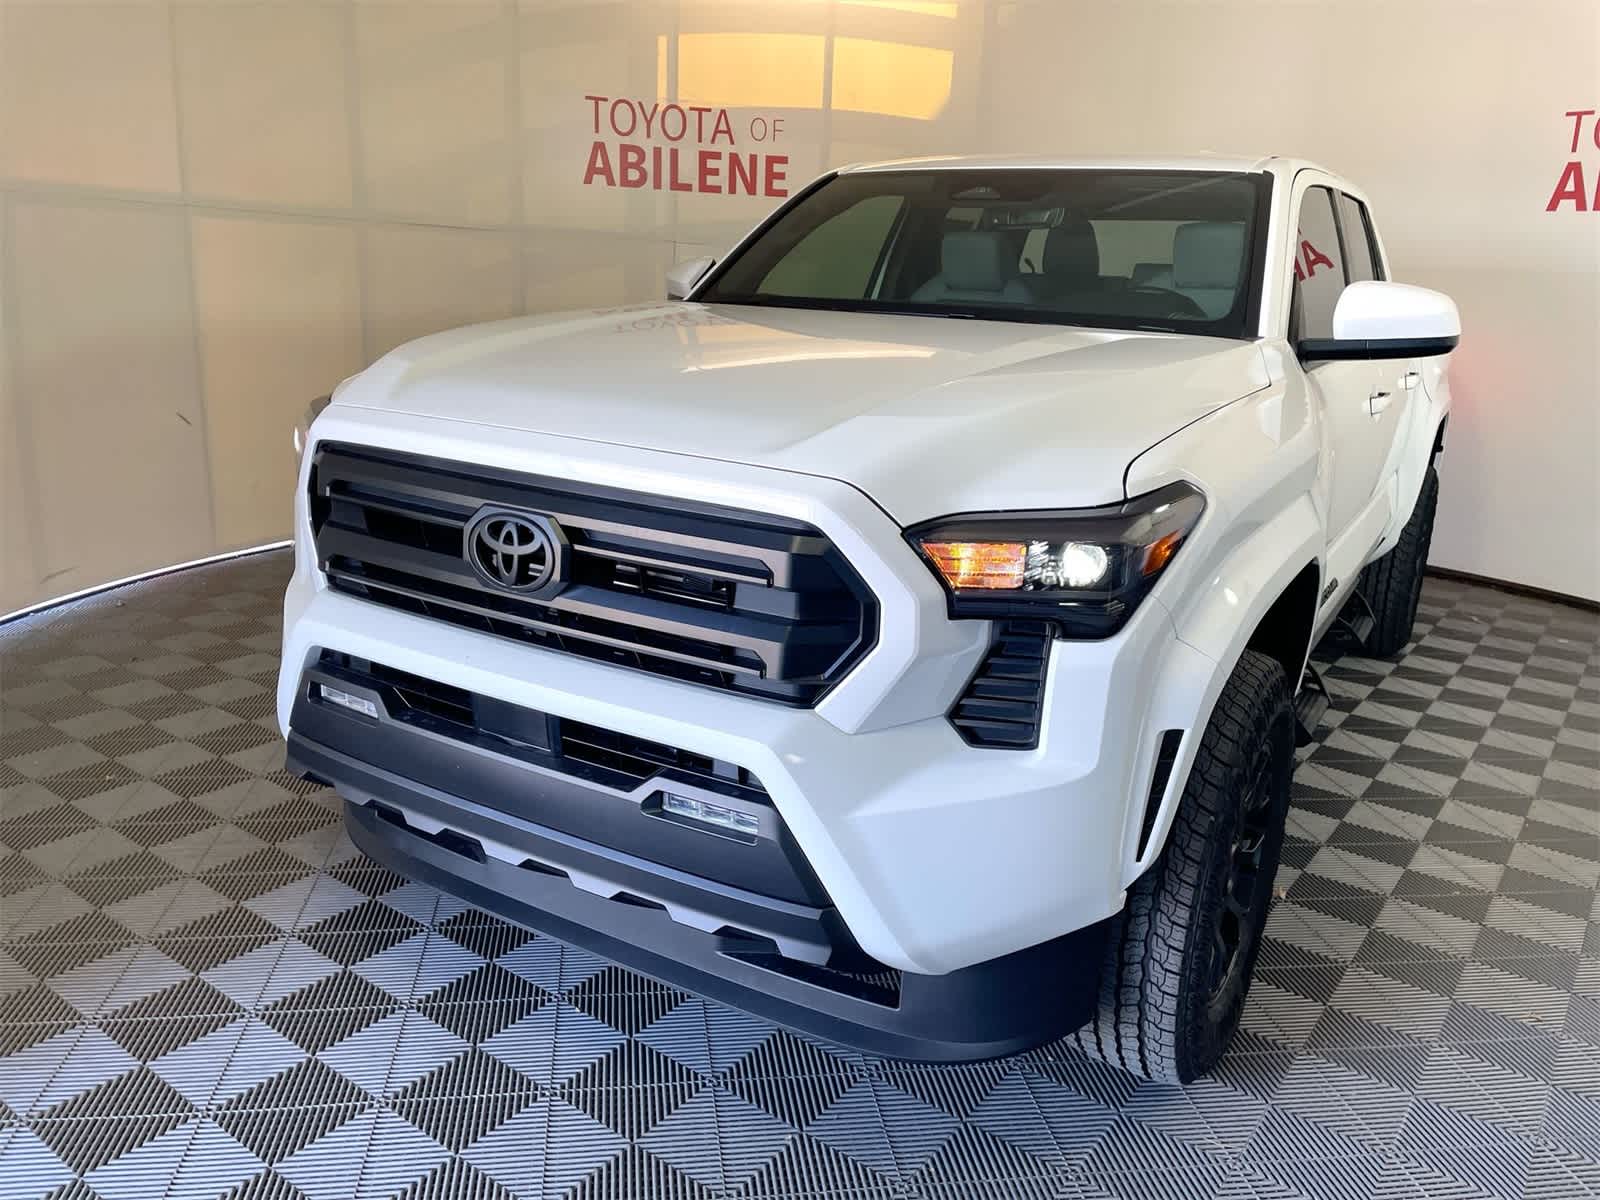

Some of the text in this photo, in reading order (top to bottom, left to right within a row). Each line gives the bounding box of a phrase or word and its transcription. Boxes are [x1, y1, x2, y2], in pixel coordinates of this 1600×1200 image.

[585, 95, 785, 145] TOYOTA OF
[1565, 110, 1600, 153] T
[583, 141, 789, 197] ABILENE
[1545, 161, 1600, 212] A
